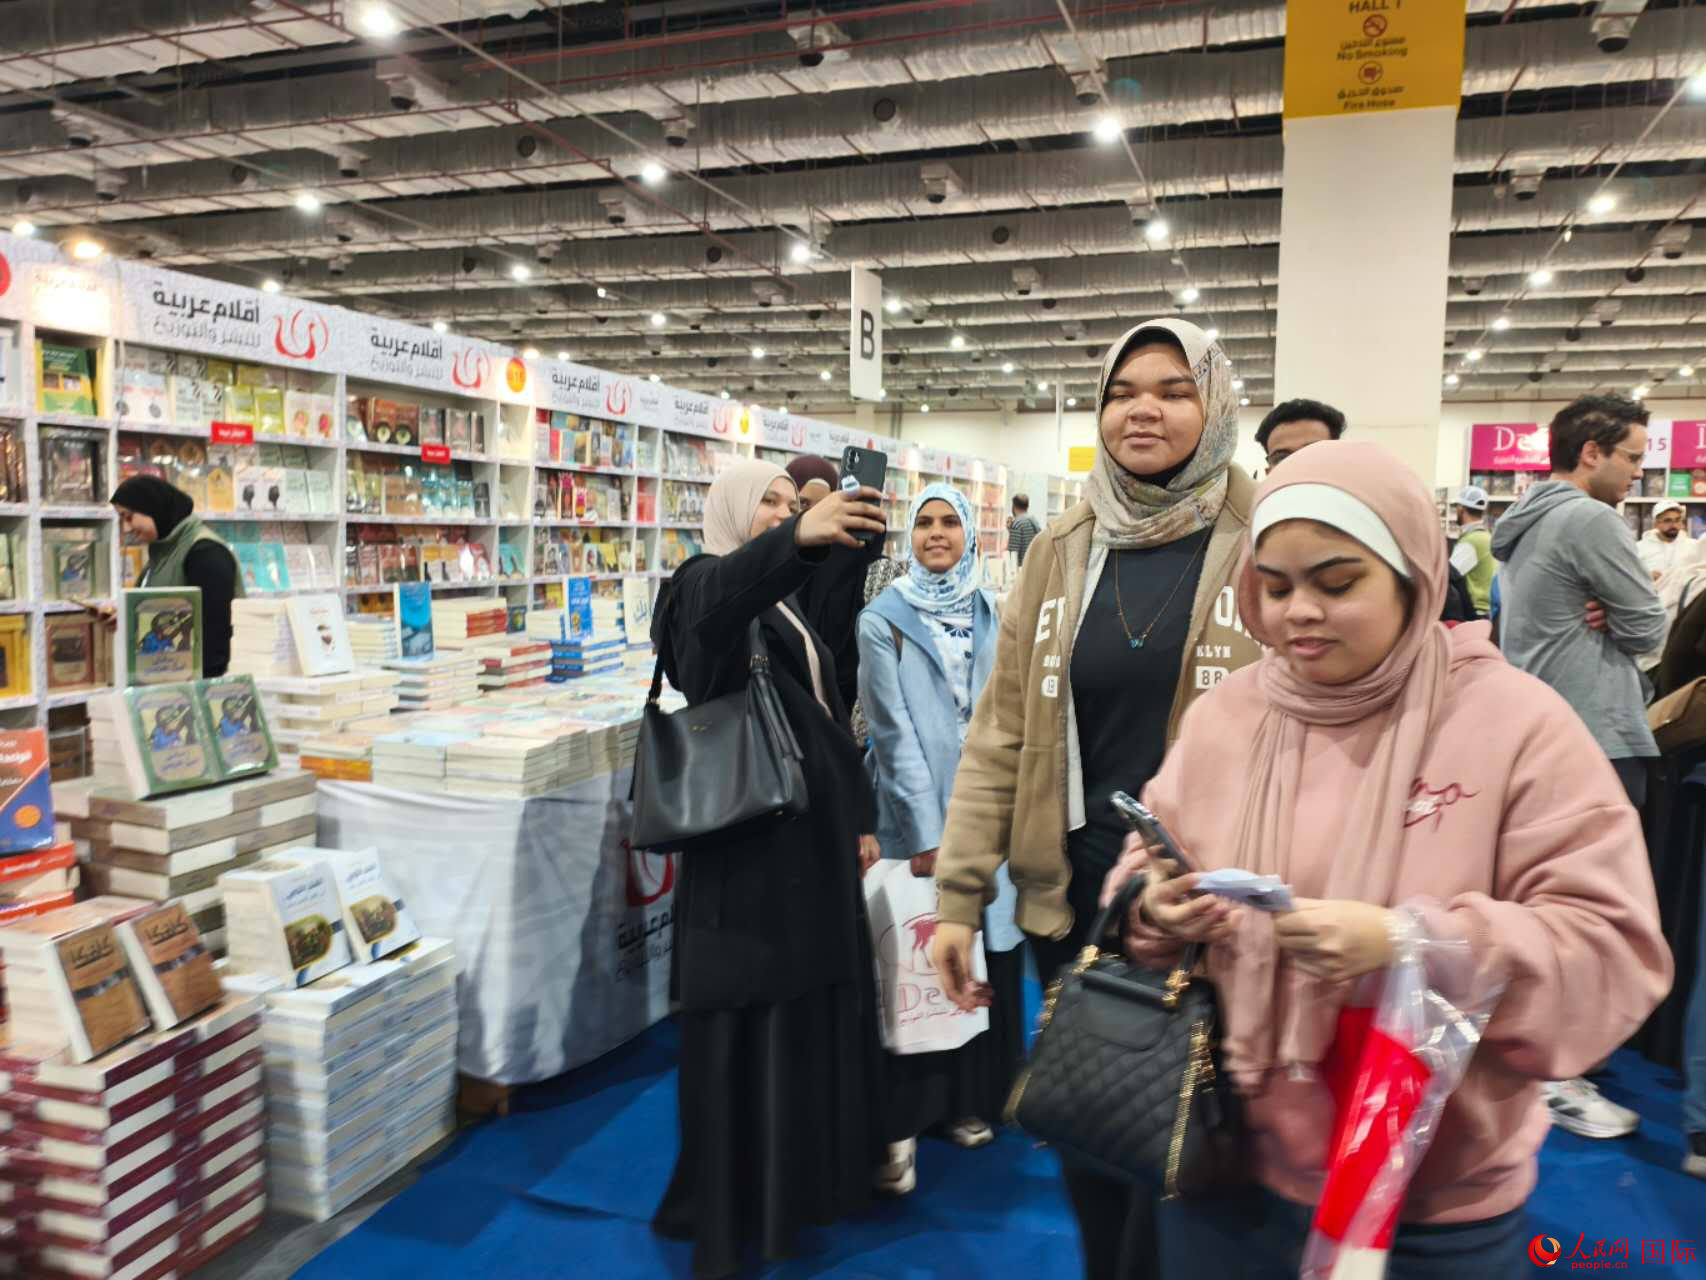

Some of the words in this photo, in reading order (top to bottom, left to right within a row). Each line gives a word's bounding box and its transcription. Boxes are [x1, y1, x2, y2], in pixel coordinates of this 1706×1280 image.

[1349, 0, 1389, 13] HALL
[1337, 51, 1353, 60] No
[1357, 47, 1407, 59] Smoking
[1344, 101, 1365, 111] Fire
[153, 280, 211, 319] عربية
[371, 326, 409, 357] عربية
[861, 309, 875, 360] B
